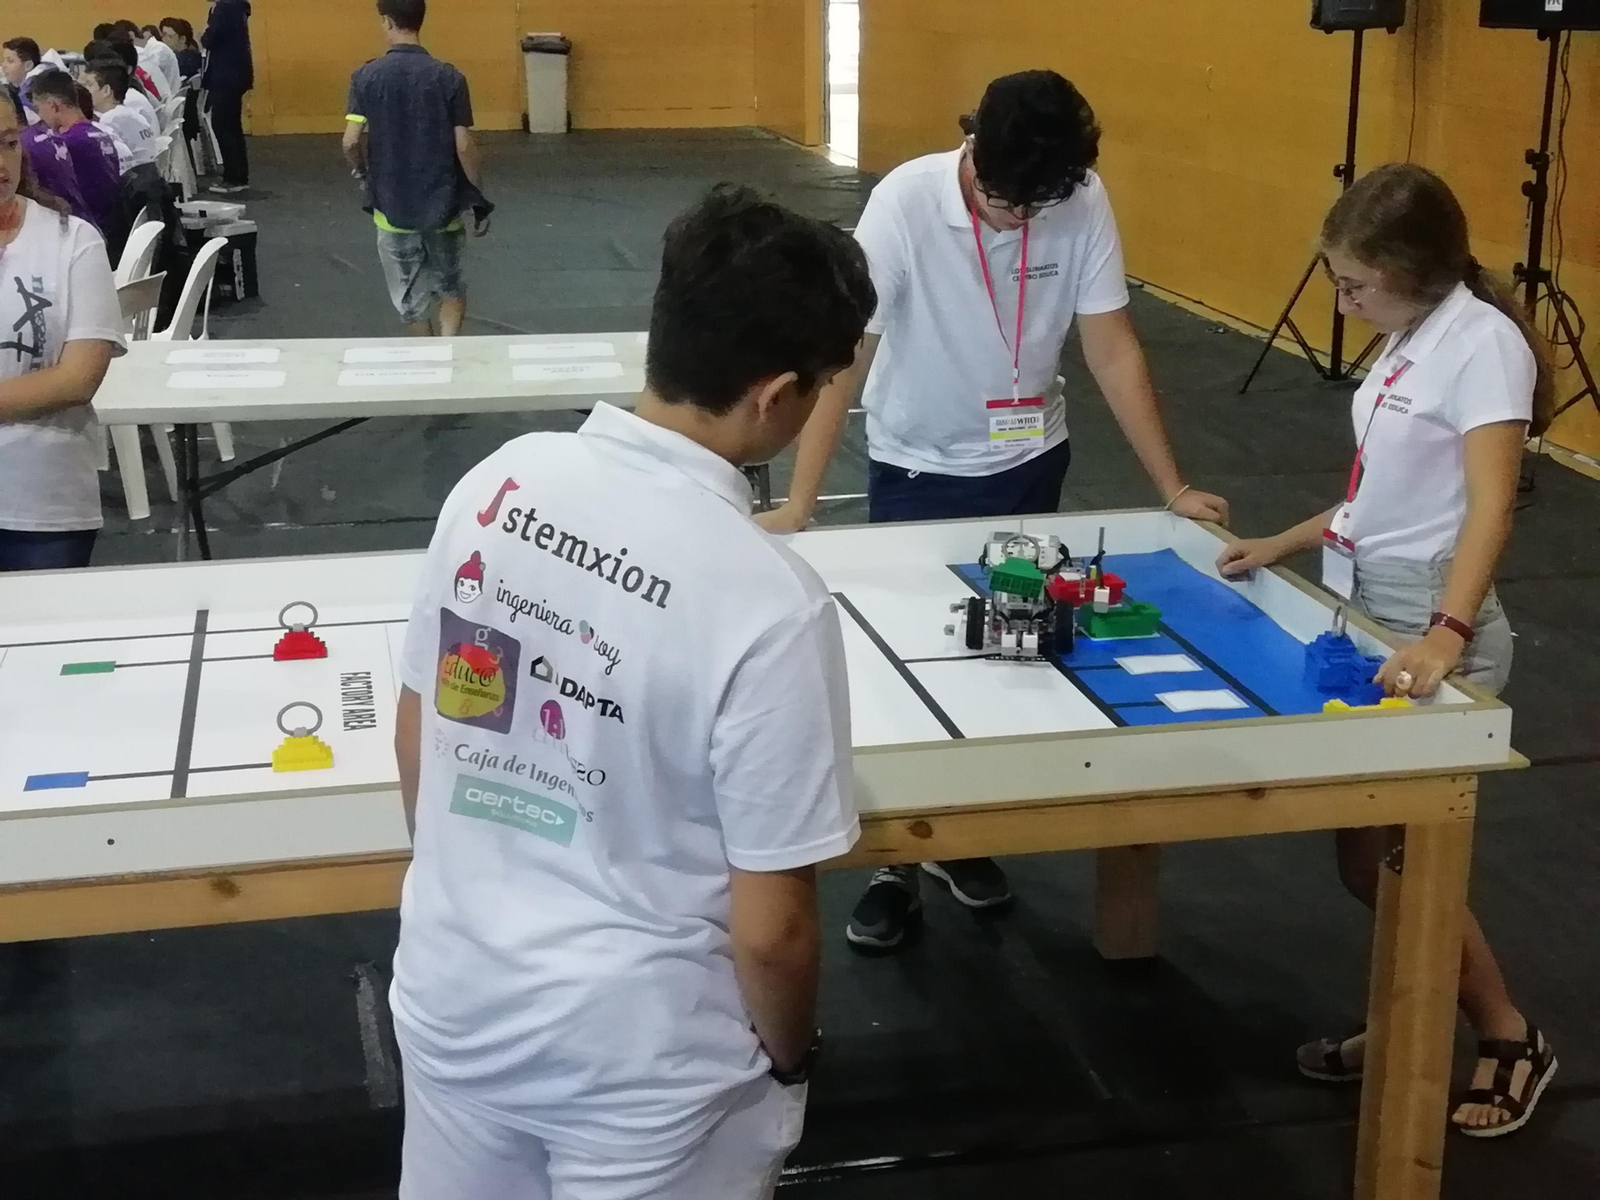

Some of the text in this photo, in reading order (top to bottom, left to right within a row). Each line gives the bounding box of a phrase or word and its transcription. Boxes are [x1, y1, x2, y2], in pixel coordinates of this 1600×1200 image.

[1012, 273, 1038, 281] CETRO
[502, 507, 672, 609] stemxion
[496, 579, 575, 636] ingeniera
[340, 671, 377, 731] FACTORY AREA
[555, 672, 625, 724] DAPTA
[454, 743, 500, 771] Caja
[503, 754, 527, 776] de
[465, 787, 557, 825] aertec
